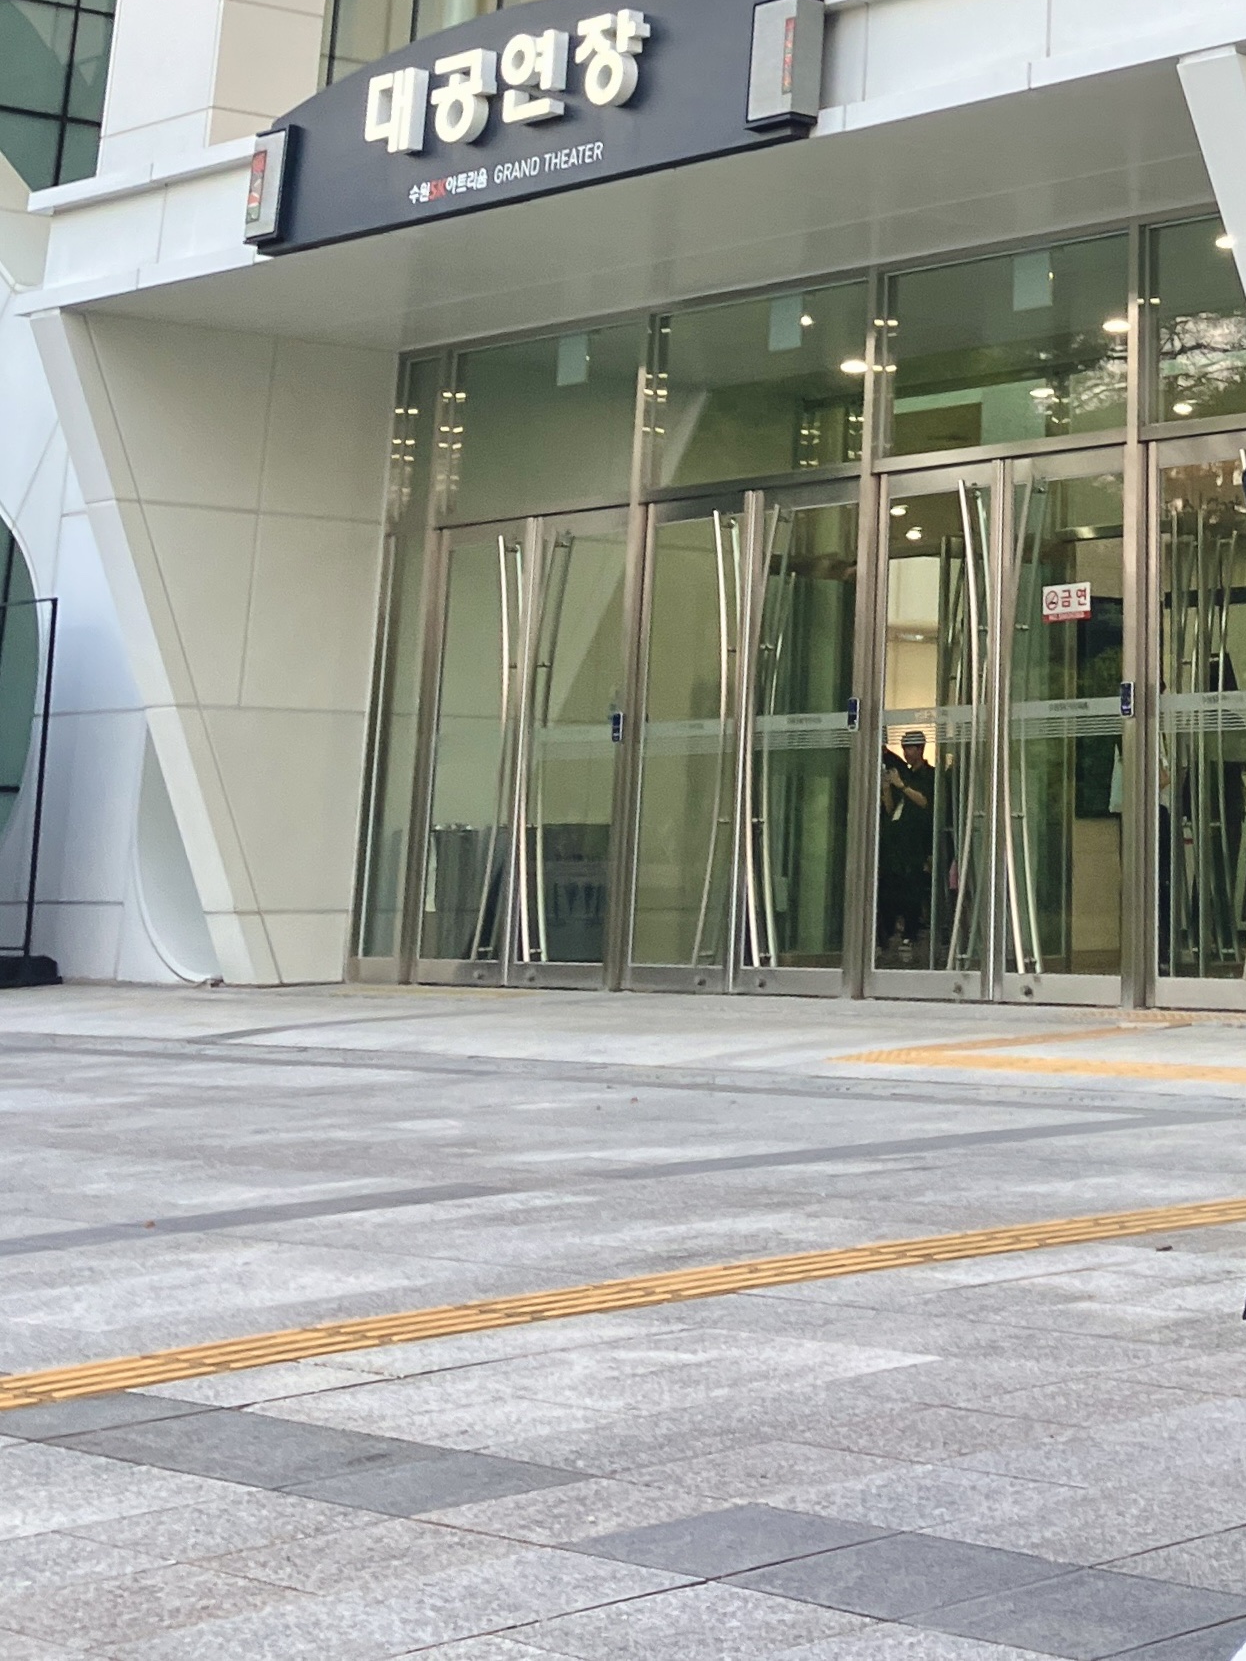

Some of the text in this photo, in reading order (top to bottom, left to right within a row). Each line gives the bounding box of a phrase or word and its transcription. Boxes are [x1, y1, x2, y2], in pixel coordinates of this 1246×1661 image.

[364, 8, 651, 154] 대공연장
[494, 156, 540, 184] GRAND
[544, 141, 605, 173] THEATER
